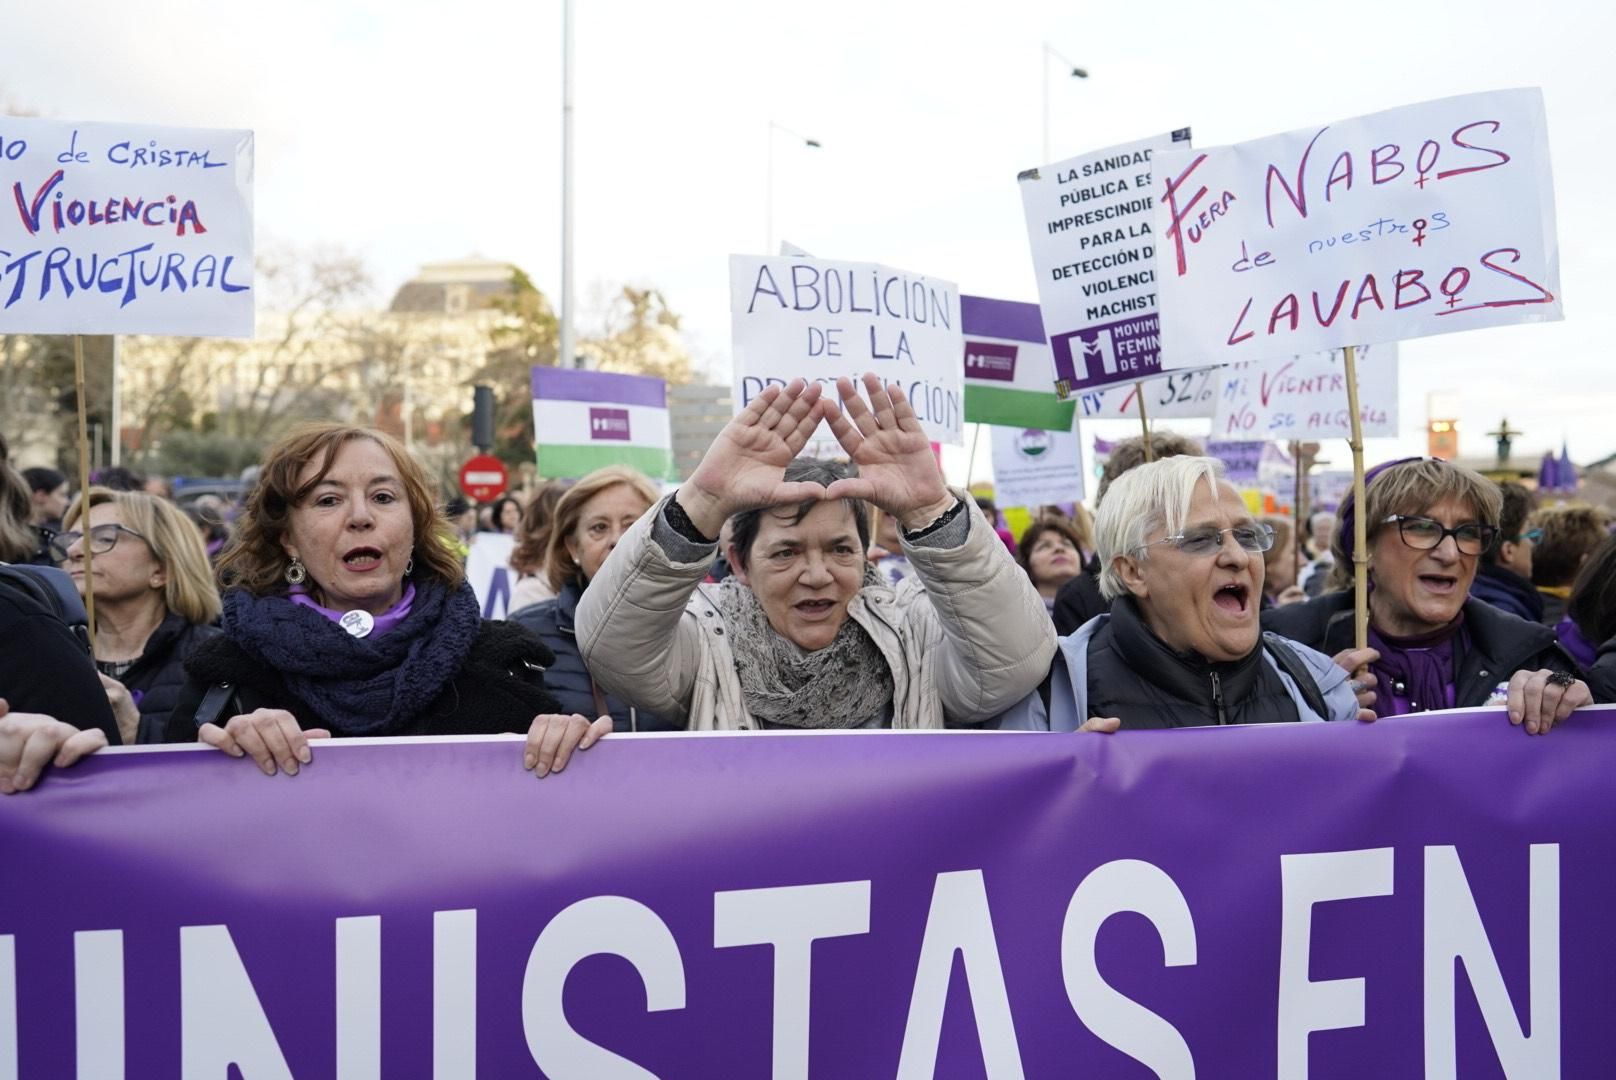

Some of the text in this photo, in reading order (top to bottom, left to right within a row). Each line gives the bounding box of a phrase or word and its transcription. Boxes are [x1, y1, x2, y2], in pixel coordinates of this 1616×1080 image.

[0, 136, 27, 160] O
[57, 130, 91, 163] de
[1057, 149, 1153, 185] LA SANIDAD
[1264, 120, 1512, 230] NABOS
[1060, 179, 1128, 207] PÚBLICA
[1080, 222, 1152, 250] PARA LA
[1052, 246, 1155, 281] DETECCIÓN D
[1231, 240, 1277, 274] de
[0, 243, 251, 309] TRUCTURAL
[1081, 270, 1155, 298] VIOLENCI
[1086, 294, 1157, 321] MACHIST
[1226, 248, 1555, 346] LAVABOS
[808, 324, 915, 365] DE LA
[1114, 318, 1159, 338] MOVIMI
[1117, 334, 1161, 356] FEMIN
[1120, 358, 1138, 372] DE
[0, 859, 1198, 1080] INISTAS
